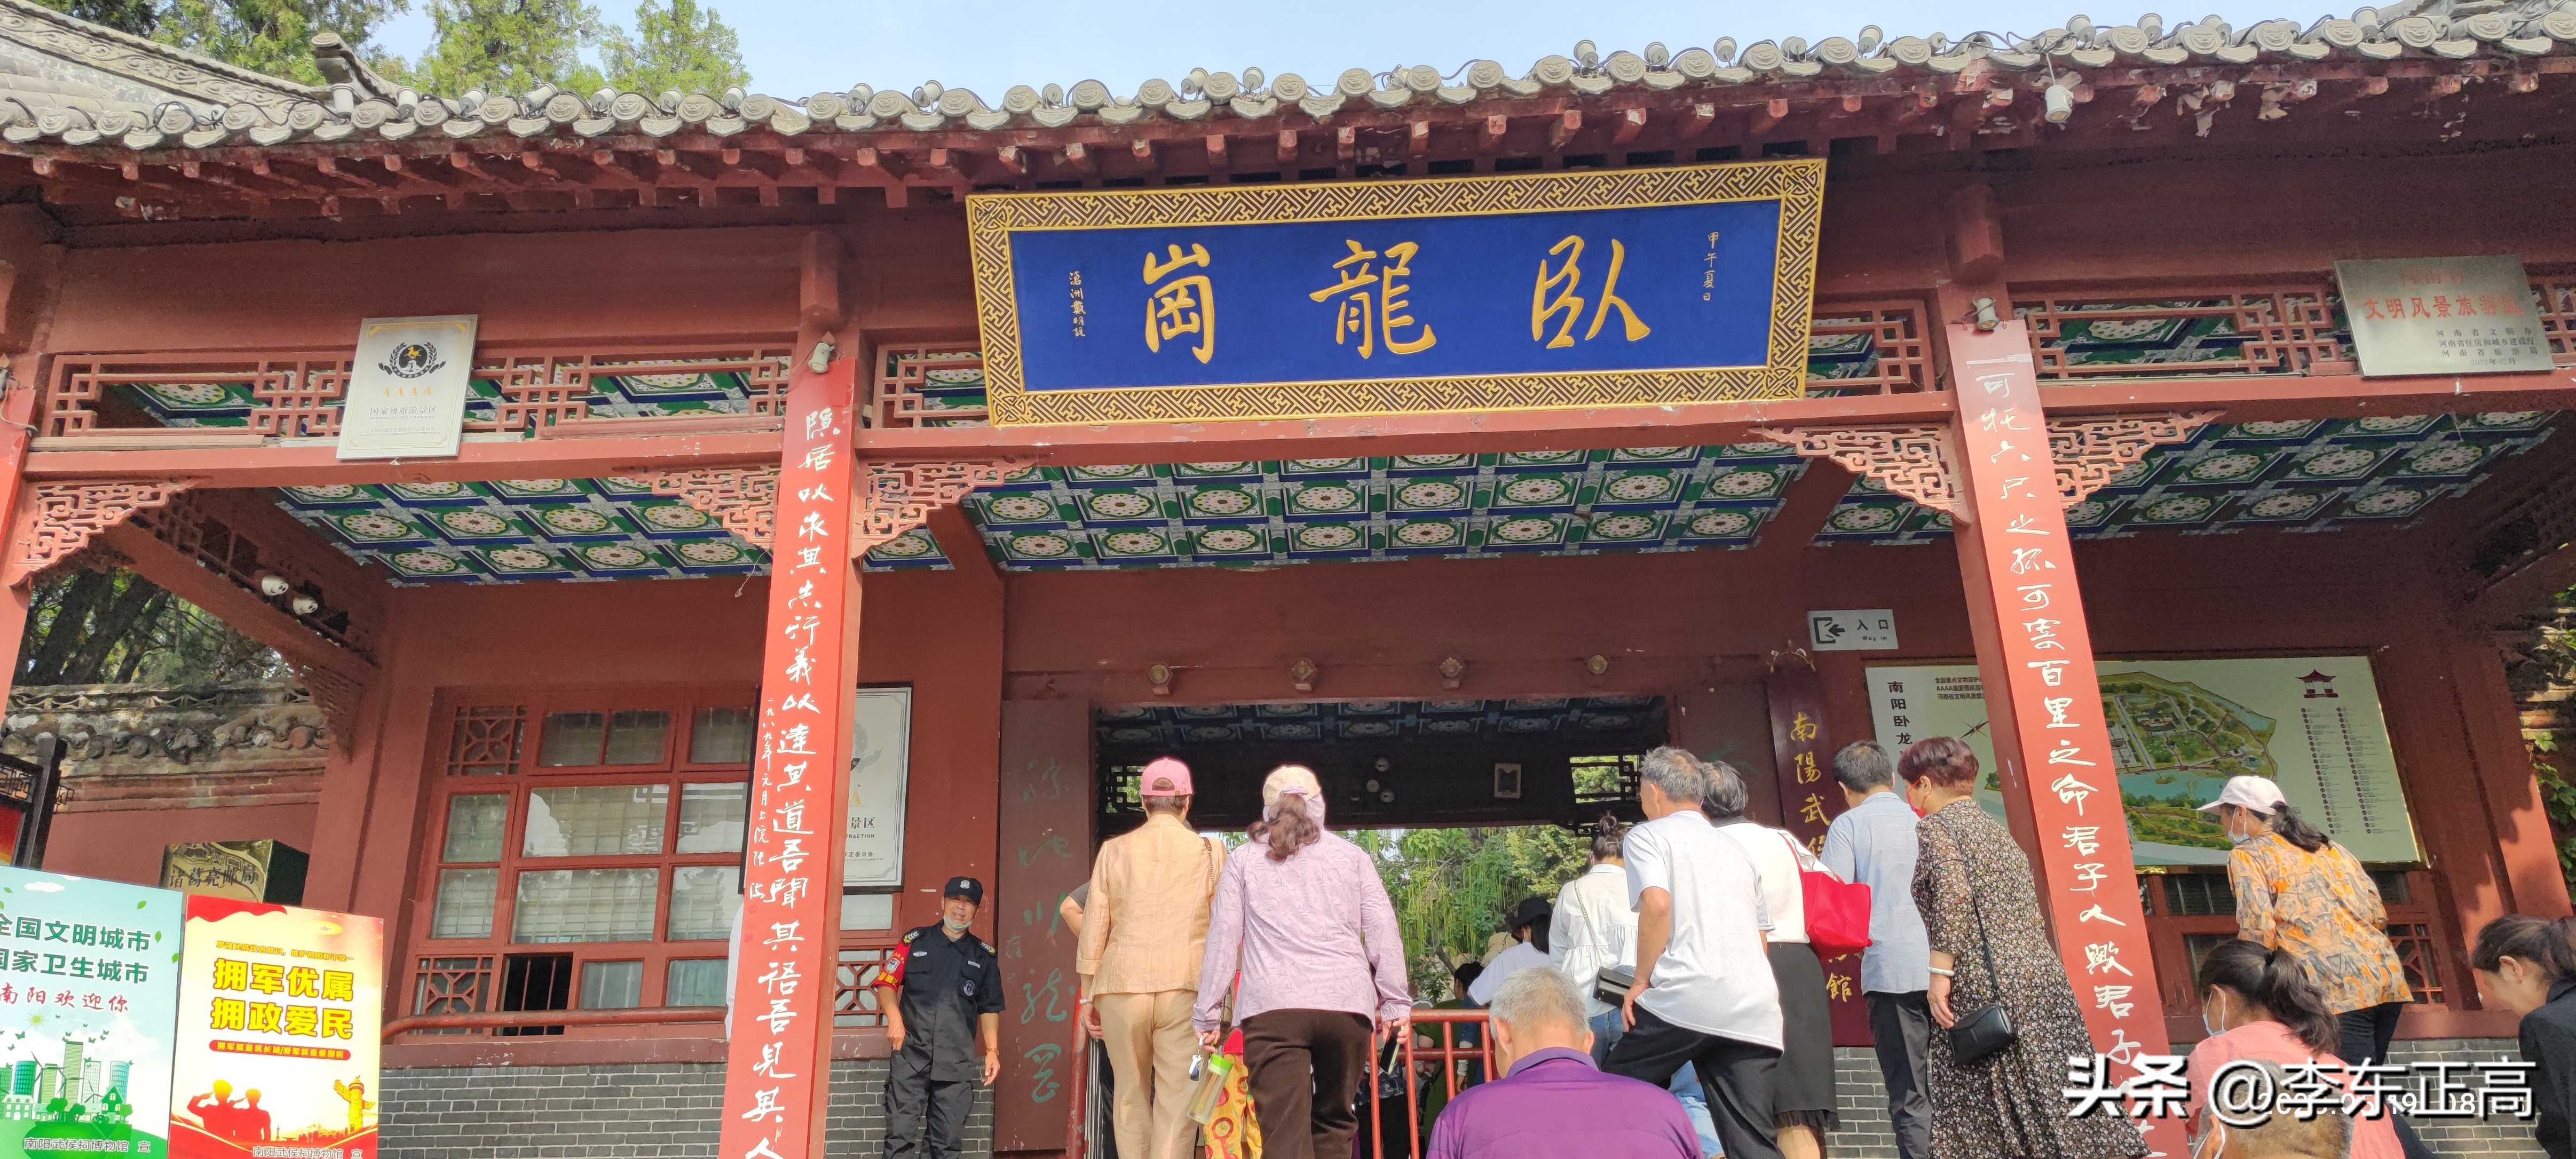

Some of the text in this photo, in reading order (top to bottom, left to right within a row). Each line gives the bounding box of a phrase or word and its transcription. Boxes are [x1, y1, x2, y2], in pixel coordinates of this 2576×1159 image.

[370, 406, 437, 416] 国家级旅游景区
[1858, 619, 1888, 630] 入口
[1887, 681, 1913, 755] 南阳卧龙
[850, 817, 875, 829] 景区
[170, 866, 257, 888] 诸葛亮邮局
[213, 958, 354, 1002] 拥军优属
[0, 982, 128, 1013] 南阳欢迎你
[211, 997, 353, 1039] 拥政爱民
[25, 1138, 128, 1152] 南阳武侯祠博物馆
[254, 1147, 343, 1159] 南阳武侯祠博物馆
